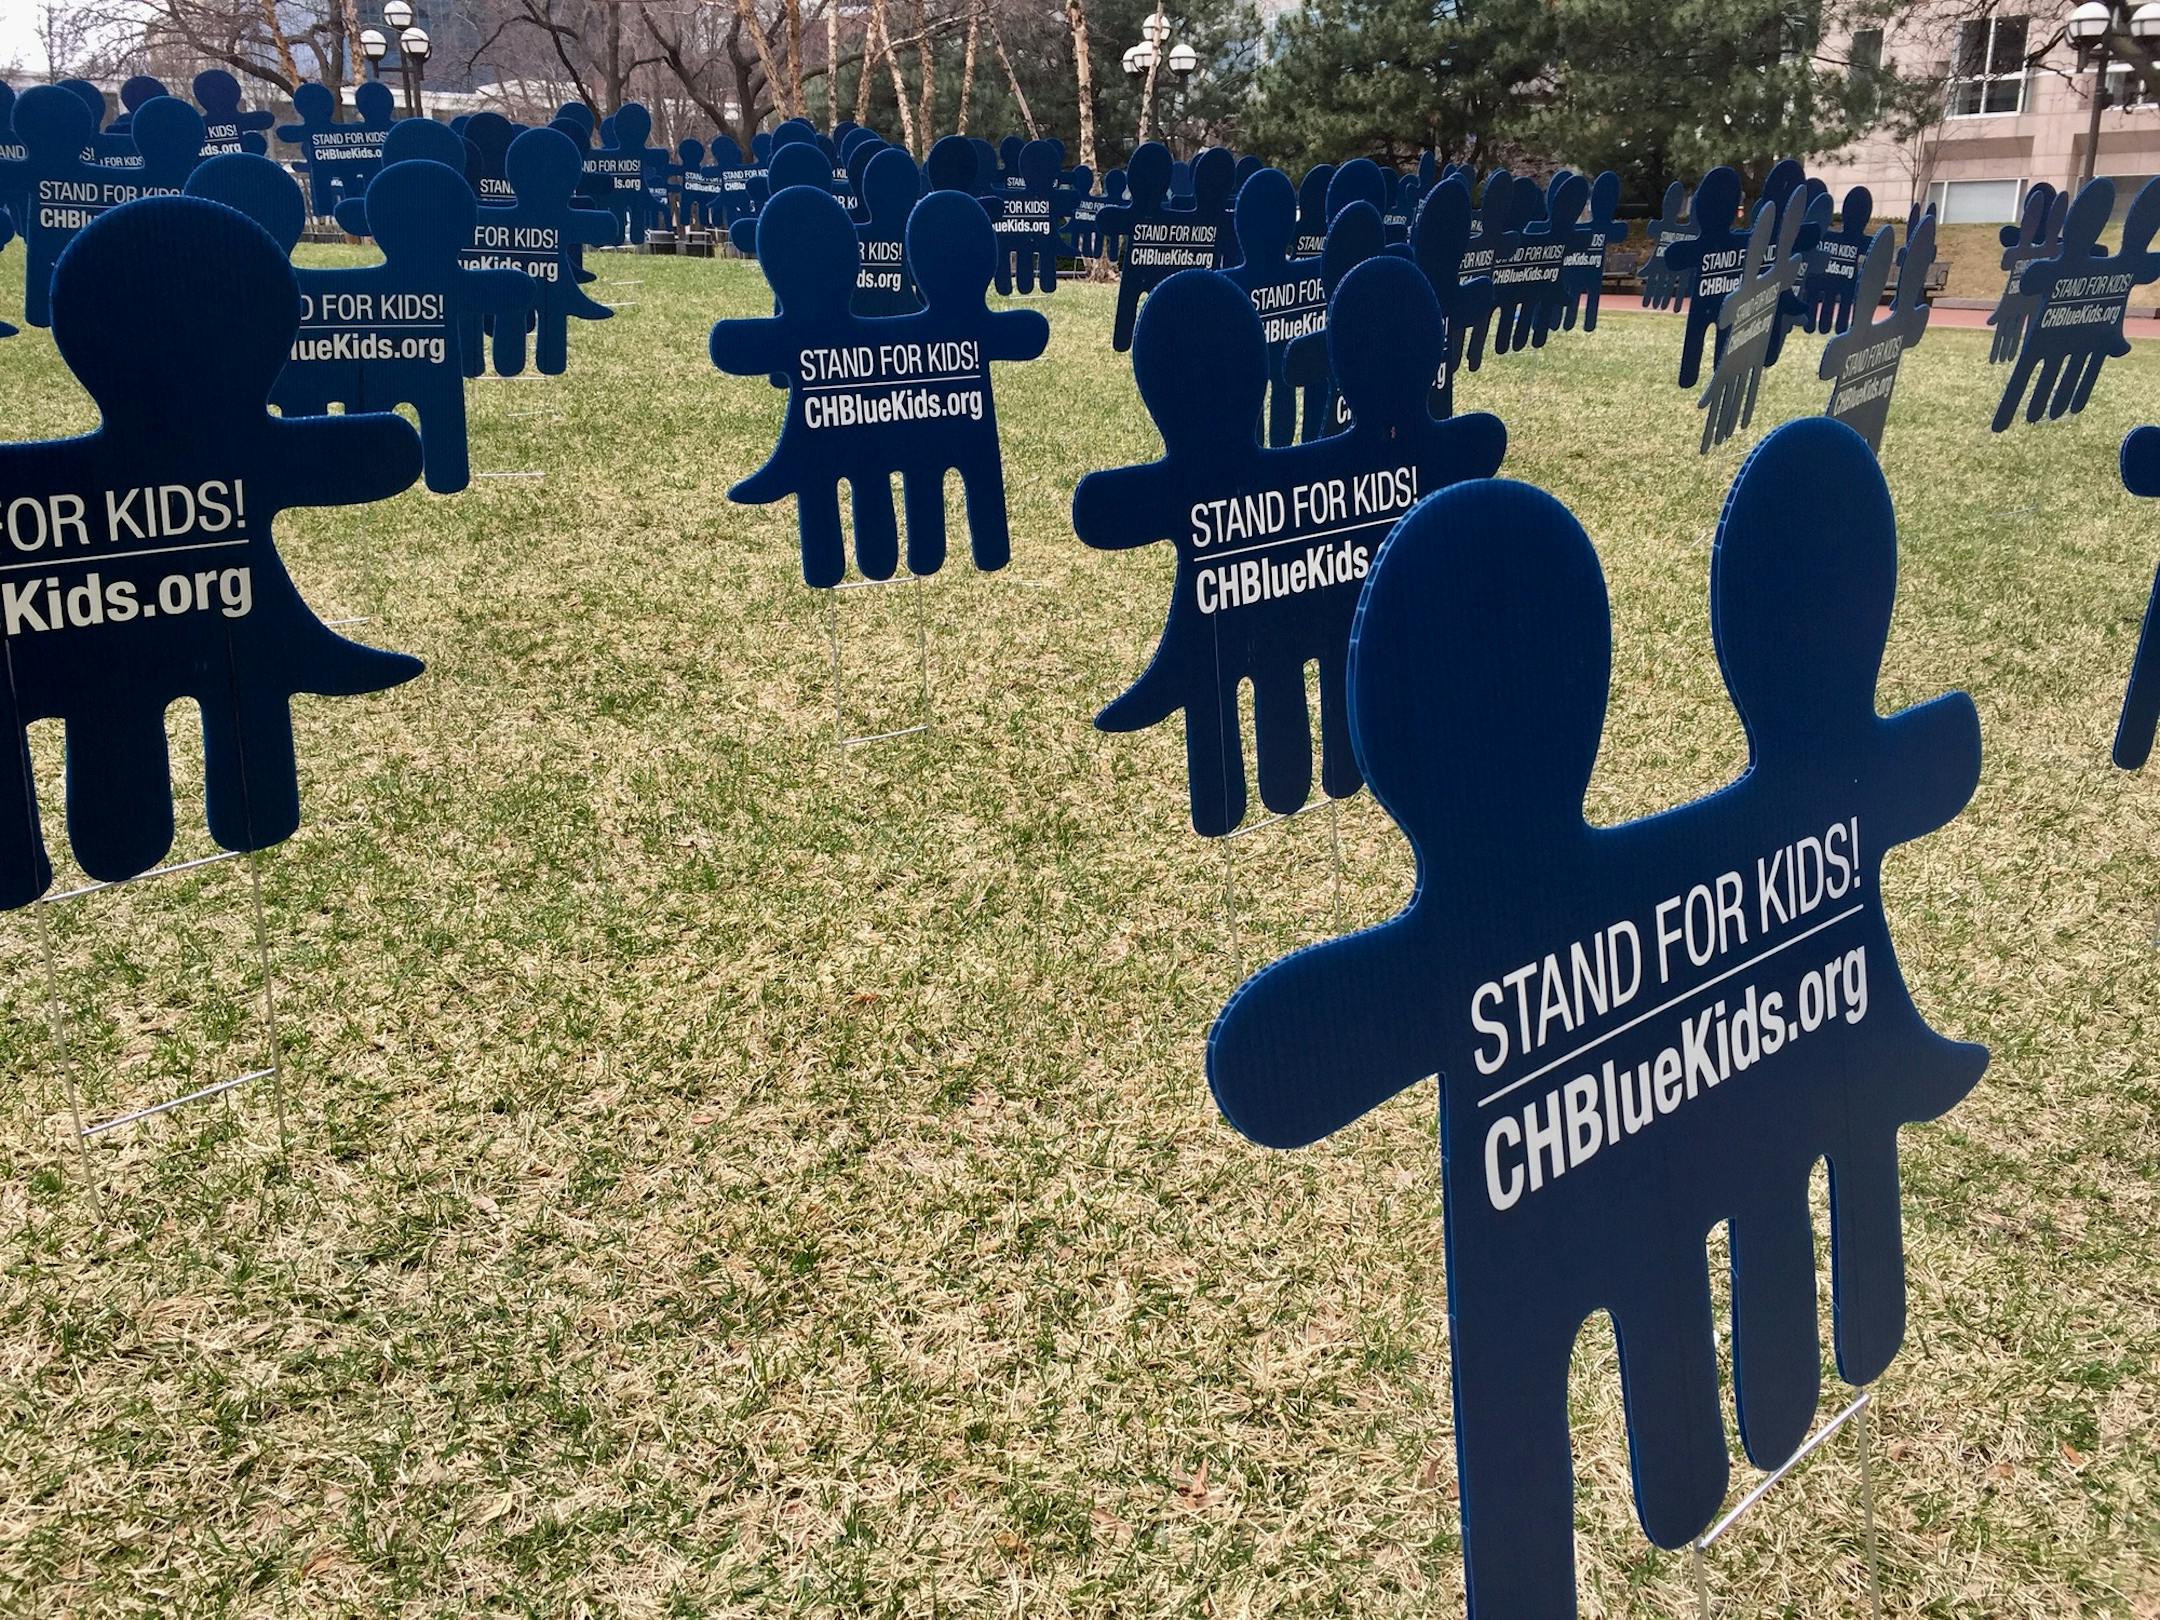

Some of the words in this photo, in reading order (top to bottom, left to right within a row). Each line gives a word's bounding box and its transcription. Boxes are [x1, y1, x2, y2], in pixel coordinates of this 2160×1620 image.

[207, 124, 238, 138] KIDS!
[312, 134, 343, 145] STAND
[344, 132, 364, 144] FOR
[598, 159, 617, 172] FOR
[39, 180, 98, 202] STAND
[103, 184, 138, 203] FOR
[480, 179, 516, 194] STAN
[1024, 200, 1050, 214] KIDS!
[474, 226, 509, 247] FOR
[514, 227, 559, 249] KIDS!
[992, 219, 1051, 236] ueKids.org
[1134, 224, 1168, 241] STAND
[1169, 225, 1190, 242] FOR
[1191, 226, 1217, 243] KIDS!
[868, 241, 903, 261] KIDS!
[1131, 248, 1214, 269] CHBlueKids.org
[1523, 246, 1543, 262] FOR
[1543, 244, 1565, 260] KIDS!
[1702, 250, 1737, 272] STAND
[1493, 267, 1560, 285] CHBlueKids.org
[2052, 279, 2088, 299] STAND
[2085, 275, 2109, 296] FOR
[2107, 273, 2134, 293] KIDS!
[322, 294, 374, 321] FOR
[380, 293, 445, 321] KIDS!
[1251, 283, 1296, 311] STAND
[2041, 304, 2121, 329] CHBlueKids.org
[800, 347, 874, 381] STAND
[880, 344, 922, 376] FOR
[927, 341, 980, 373] KIDS!
[804, 388, 983, 429] CHBlueKids.org
[0, 494, 90, 551] OR
[105, 479, 246, 542] KIDS!
[1191, 490, 1286, 548] STAND
[1293, 479, 1346, 528] FOR
[1353, 466, 1419, 515] KIDS!
[1, 567, 253, 636] Kids.org
[1471, 920, 1642, 1075] STAND
[1655, 870, 1748, 984] FOR
[1757, 816, 1862, 933] KIDS!
[1485, 945, 1868, 1211] CHBlueKids.org
